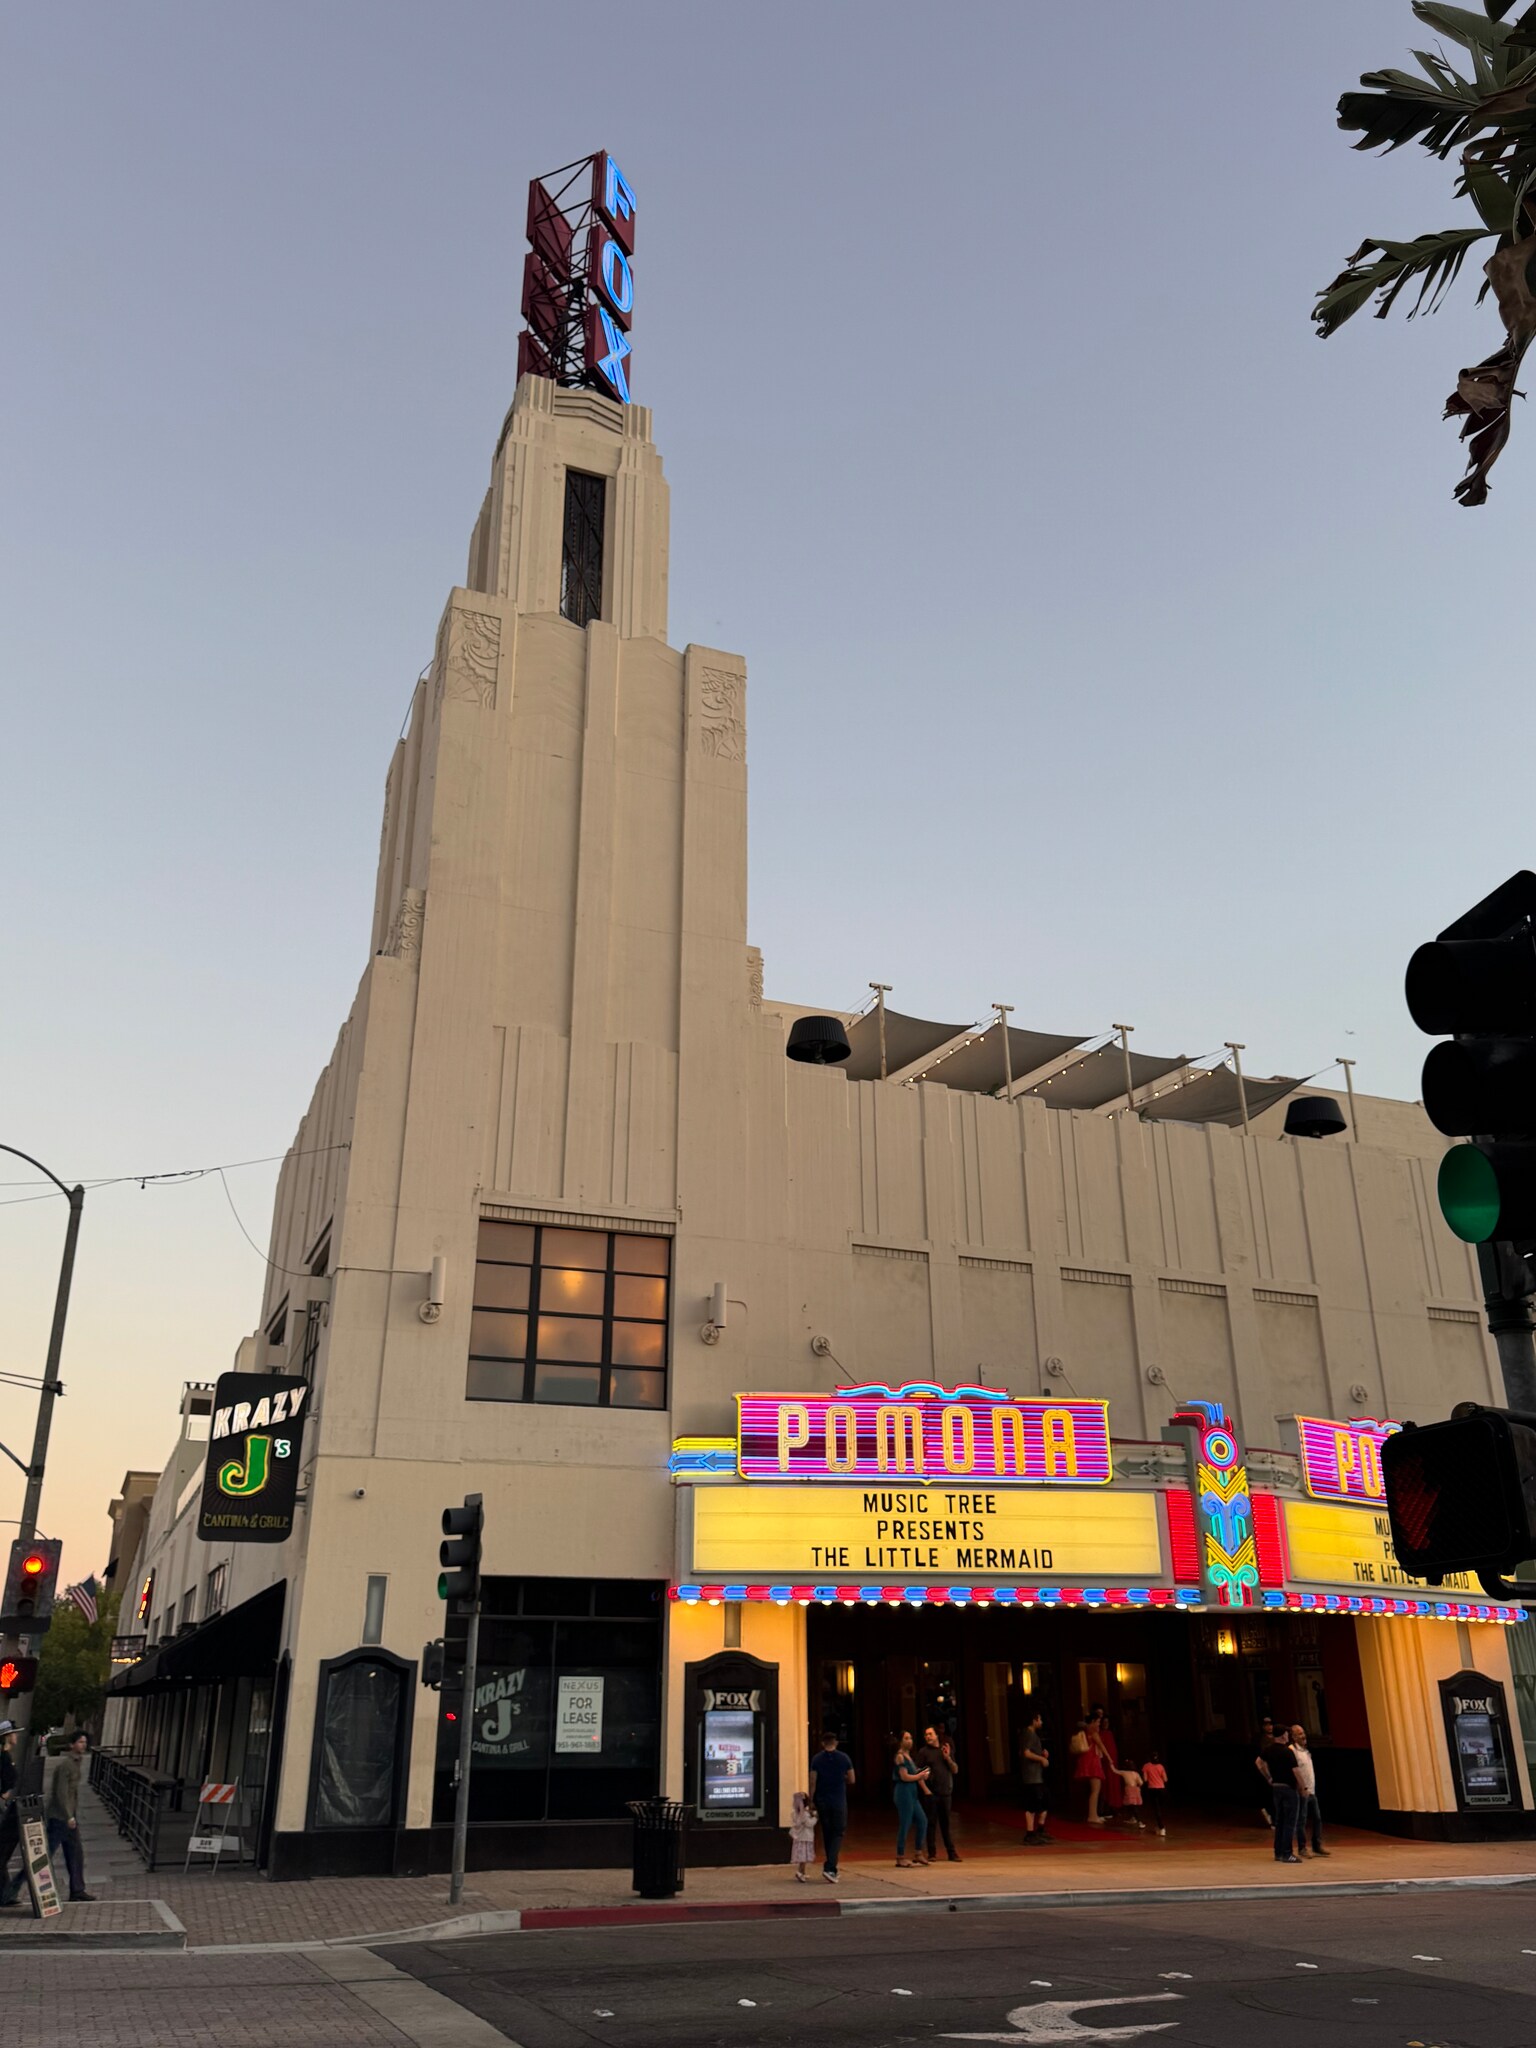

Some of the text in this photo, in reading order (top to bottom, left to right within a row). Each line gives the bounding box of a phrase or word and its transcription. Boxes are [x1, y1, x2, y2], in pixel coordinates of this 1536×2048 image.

[597, 154, 637, 405] FOX
[212, 1386, 308, 1441] KRAZY
[777, 1404, 1078, 1477] POMONA
[863, 1493, 997, 1514] MUSIC TREE
[203, 1512, 248, 1528] CANTINA
[877, 1520, 985, 1541] PRESENTS
[811, 1547, 1053, 1569] THE LITTLE MERMAID
[1353, 1562, 1374, 1582] THE
[476, 1668, 526, 1708] KRAZY
[563, 1681, 599, 1690] NEXUS
[569, 1697, 593, 1709] FOR
[715, 1692, 749, 1706] FOX
[1461, 1699, 1486, 1710] FOX
[563, 1712, 598, 1724] LEASE
[705, 1811, 735, 1819] COMING
